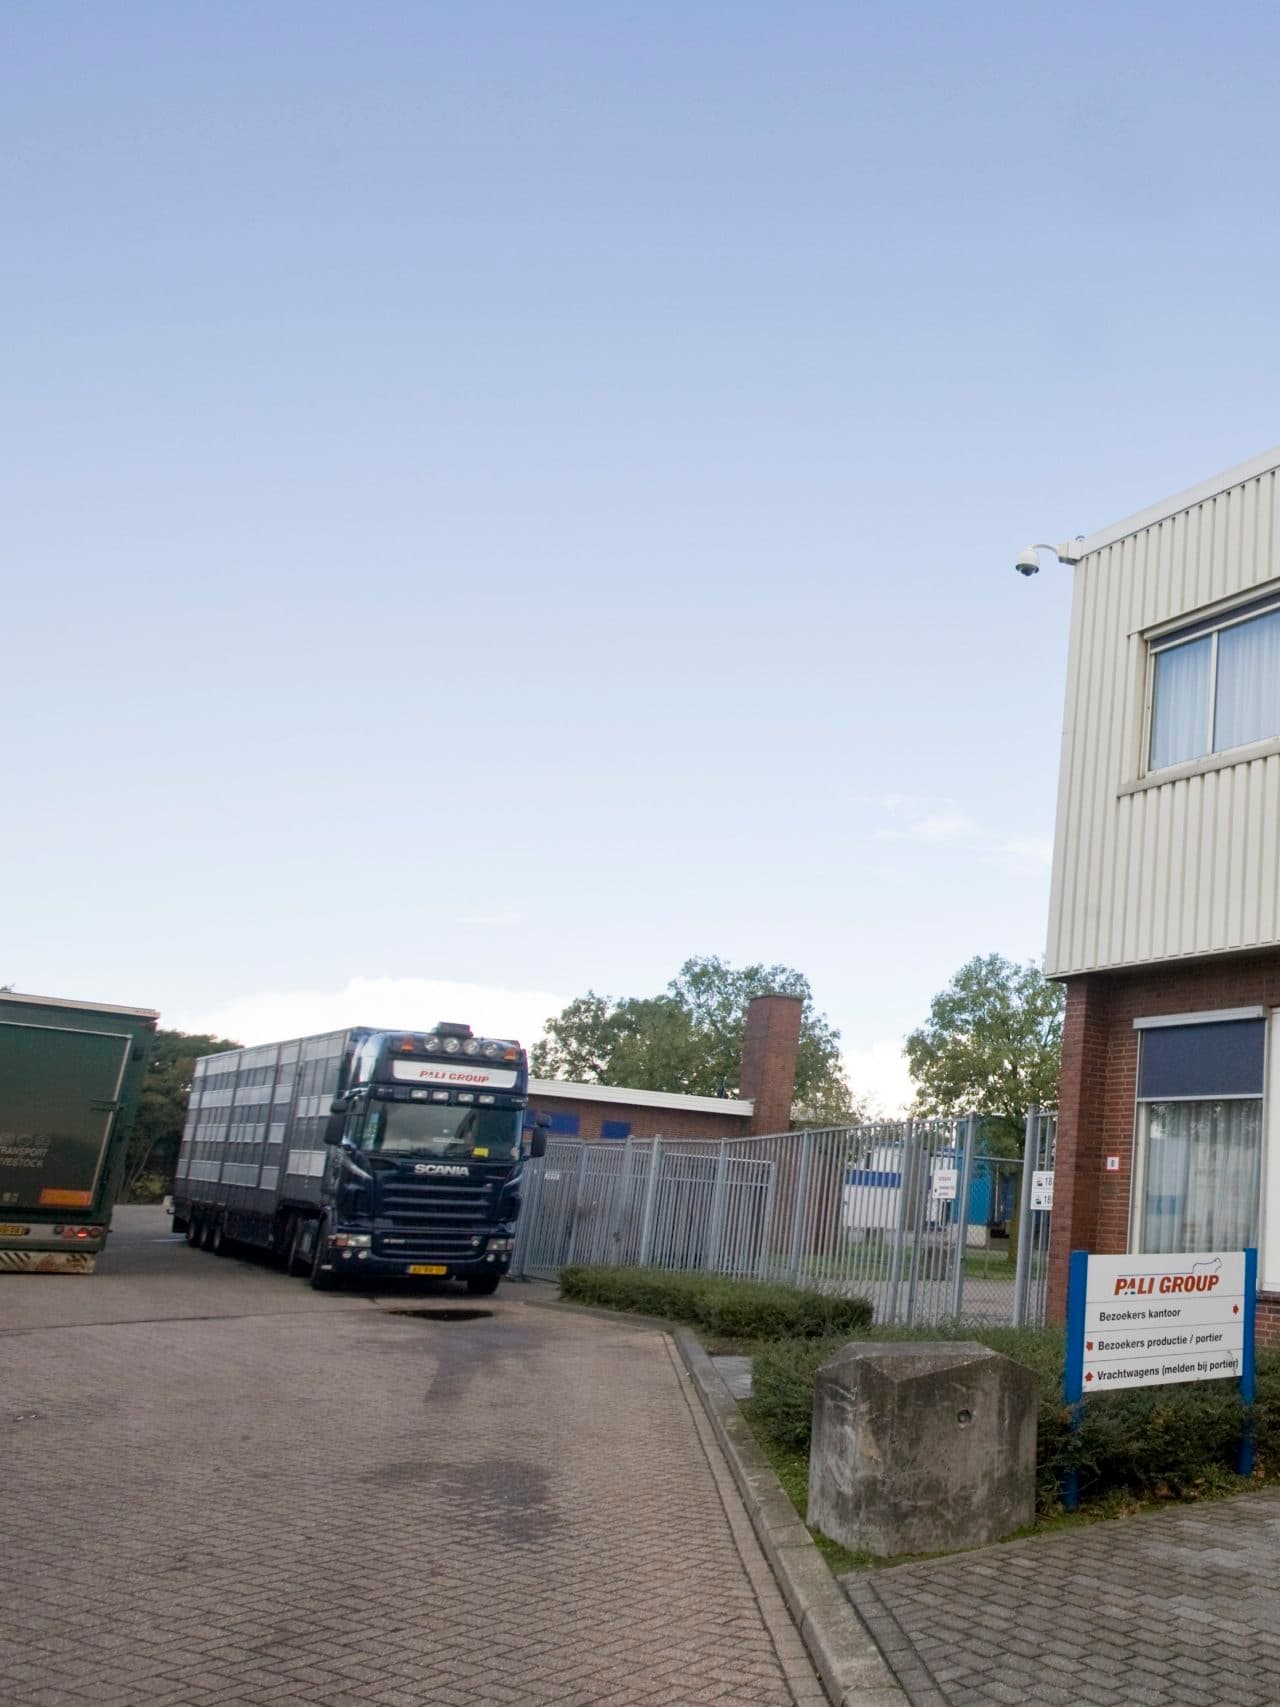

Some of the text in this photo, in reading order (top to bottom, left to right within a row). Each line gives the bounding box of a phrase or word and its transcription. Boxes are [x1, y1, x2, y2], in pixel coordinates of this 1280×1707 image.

[419, 1070, 490, 1083] PALI GROUP
[0, 1146, 48, 1158] RANSPORT
[414, 1163, 470, 1176] SCANIA
[1113, 1274, 1220, 1296] PALI GROUP
[1099, 1308, 1181, 1322] Bezoekers kantoor
[1098, 1333, 1223, 1351] Bezoekers productie / portier
[1097, 1358, 1239, 1382] Vrachtwagens (melden bij portier)
